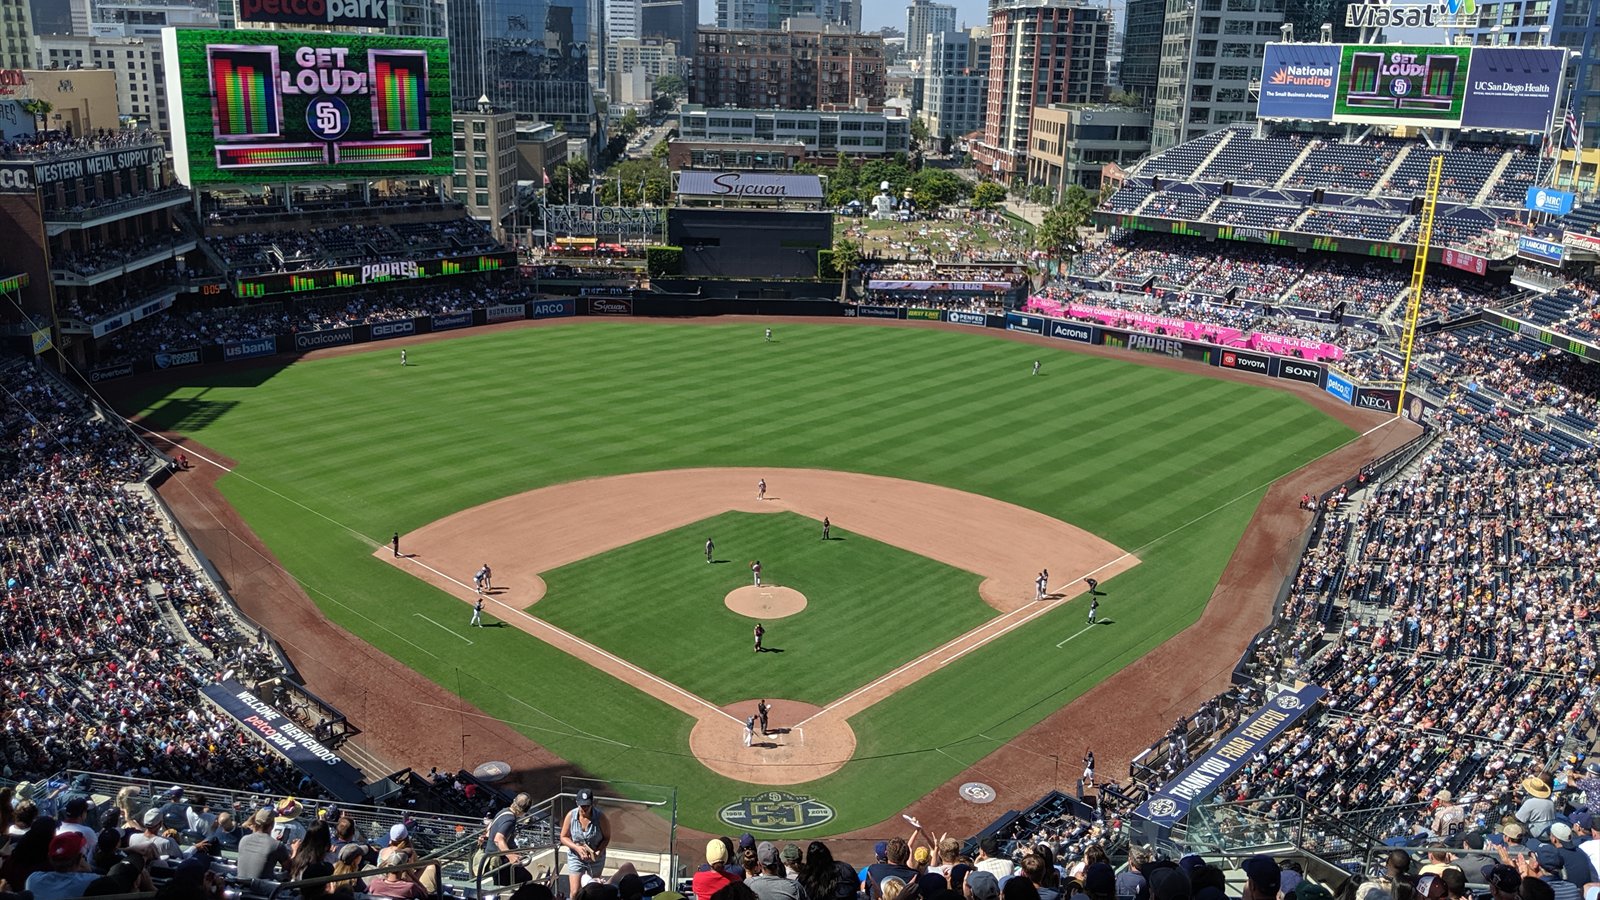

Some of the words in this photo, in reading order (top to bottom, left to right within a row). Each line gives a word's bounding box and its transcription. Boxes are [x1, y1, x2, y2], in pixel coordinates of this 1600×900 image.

[1351, 4, 1435, 27] Viasat
[295, 46, 349, 68] GET
[1391, 53, 1418, 64] GET
[1287, 66, 1333, 76] National
[1382, 64, 1426, 77] LOUD!
[281, 68, 368, 94] LOUD!
[1286, 76, 1332, 87] Funding
[1474, 81, 1487, 91] UC
[1487, 82, 1502, 91] San
[1502, 82, 1524, 93] Diego
[1525, 83, 1550, 92] Health
[35, 159, 84, 184] WESTERN
[87, 156, 117, 174] METAL
[118, 149, 151, 169] SUPPLY
[152, 147, 166, 161] CO.
[712, 173, 788, 200] Sycuan
[538, 203, 666, 223] NATIONAL
[549, 221, 656, 236] UNIVERSITY
[1234, 228, 1269, 241] PADRES
[362, 260, 418, 284] PADRES
[488, 306, 522, 316] BUDWEISER
[535, 303, 563, 315] ARCO
[593, 300, 626, 313] Sycuan
[959, 314, 984, 322] PENFED
[1124, 313, 1143, 322] MORE
[1168, 319, 1186, 329] FANS
[373, 321, 413, 335] GEICO
[1054, 325, 1088, 339] Acronis
[298, 332, 351, 346] Qualcomm
[1261, 334, 1282, 344] HOME
[1300, 341, 1321, 351] DECK
[1127, 334, 1183, 359] PADRES
[1238, 358, 1266, 369] TOYOTA
[1285, 365, 1318, 378] SONY
[1329, 379, 1344, 393] petco
[1360, 395, 1392, 411] NECA
[236, 690, 281, 721] WELCOME
[280, 722, 341, 765] BIENVENIDOS
[1169, 770, 1216, 800] THANK
[1197, 756, 1230, 776] YOU
[1216, 736, 1256, 761] FRIAR
[1241, 709, 1290, 741] FAITHFUL
